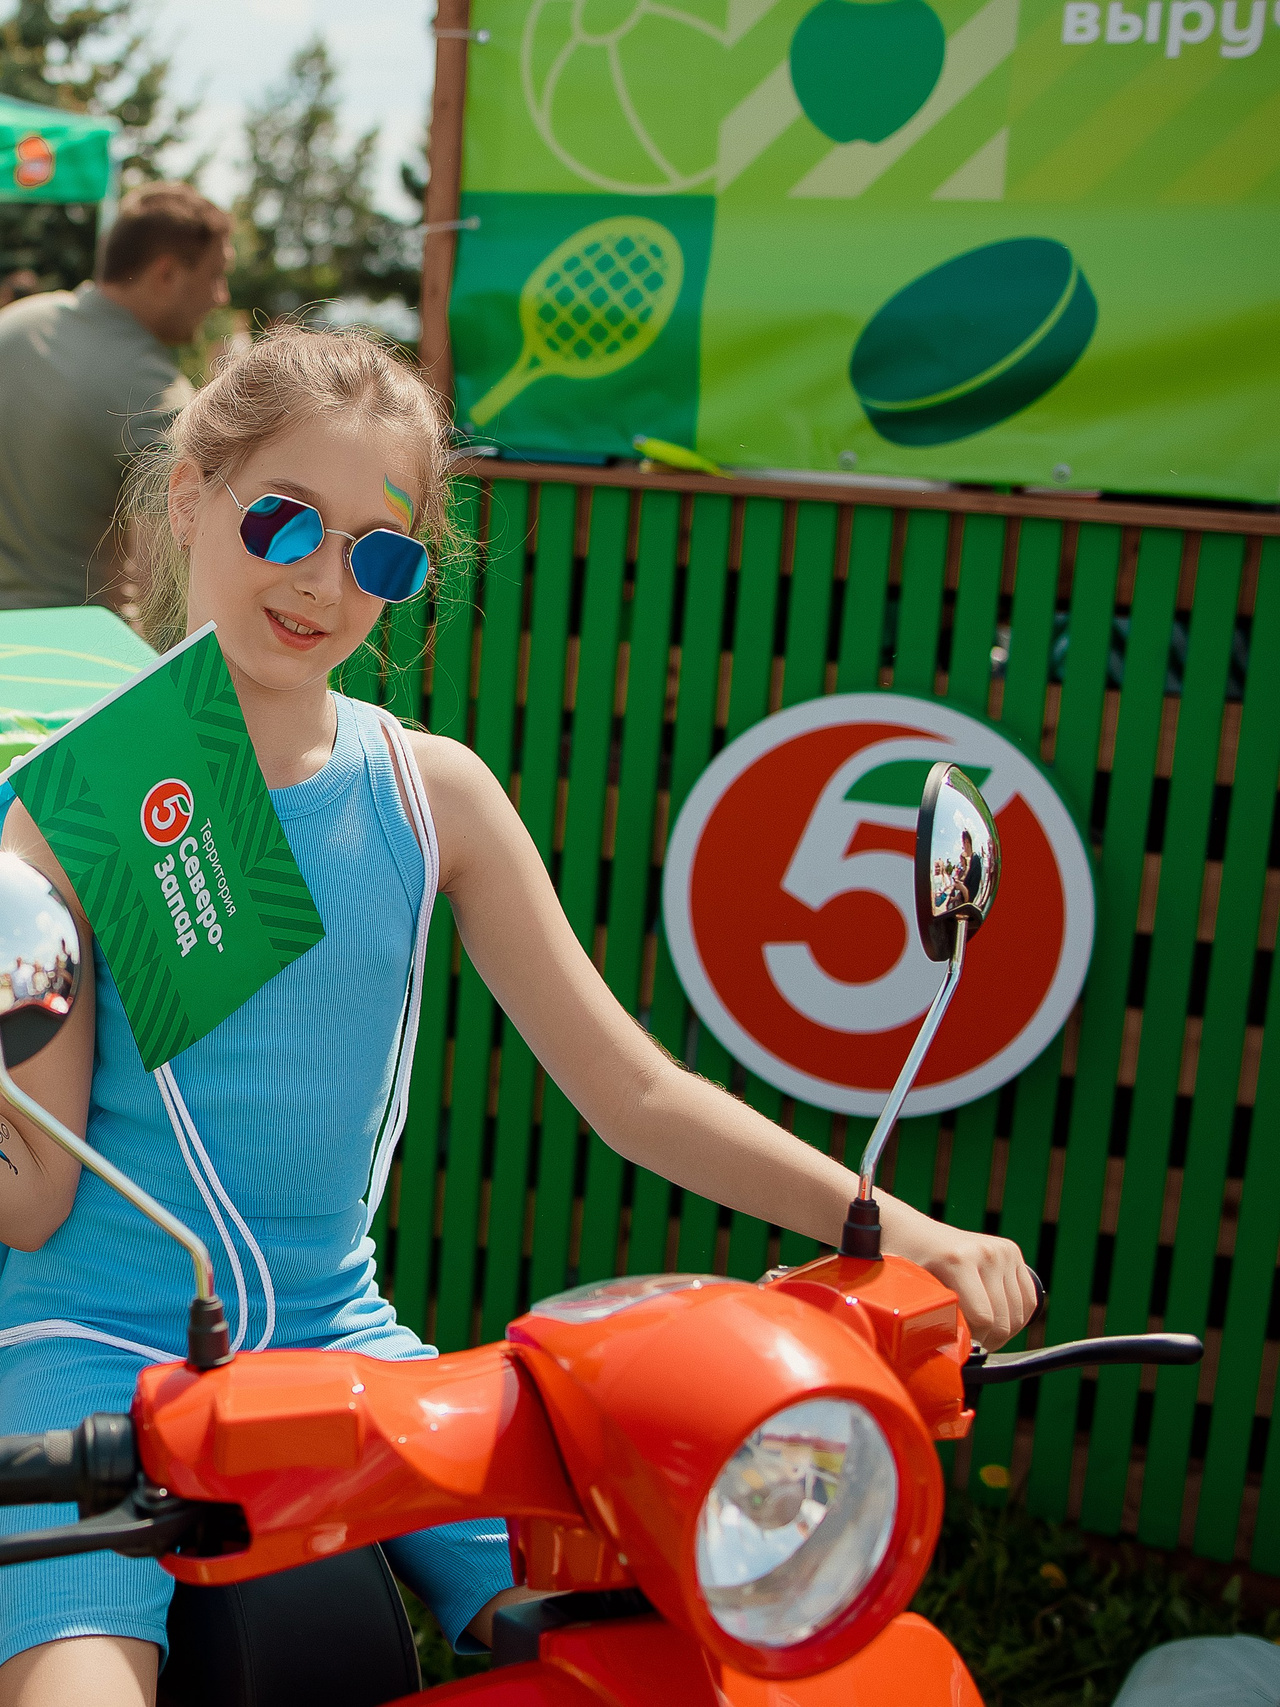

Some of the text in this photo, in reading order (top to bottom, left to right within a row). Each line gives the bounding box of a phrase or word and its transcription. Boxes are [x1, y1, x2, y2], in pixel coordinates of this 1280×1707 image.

[1062, 0, 1280, 59] выру
[153, 853, 198, 957] Запад
[179, 836, 224, 954] Северо-
[200, 818, 237, 917] Территория
[762, 735, 1010, 1034] 5
